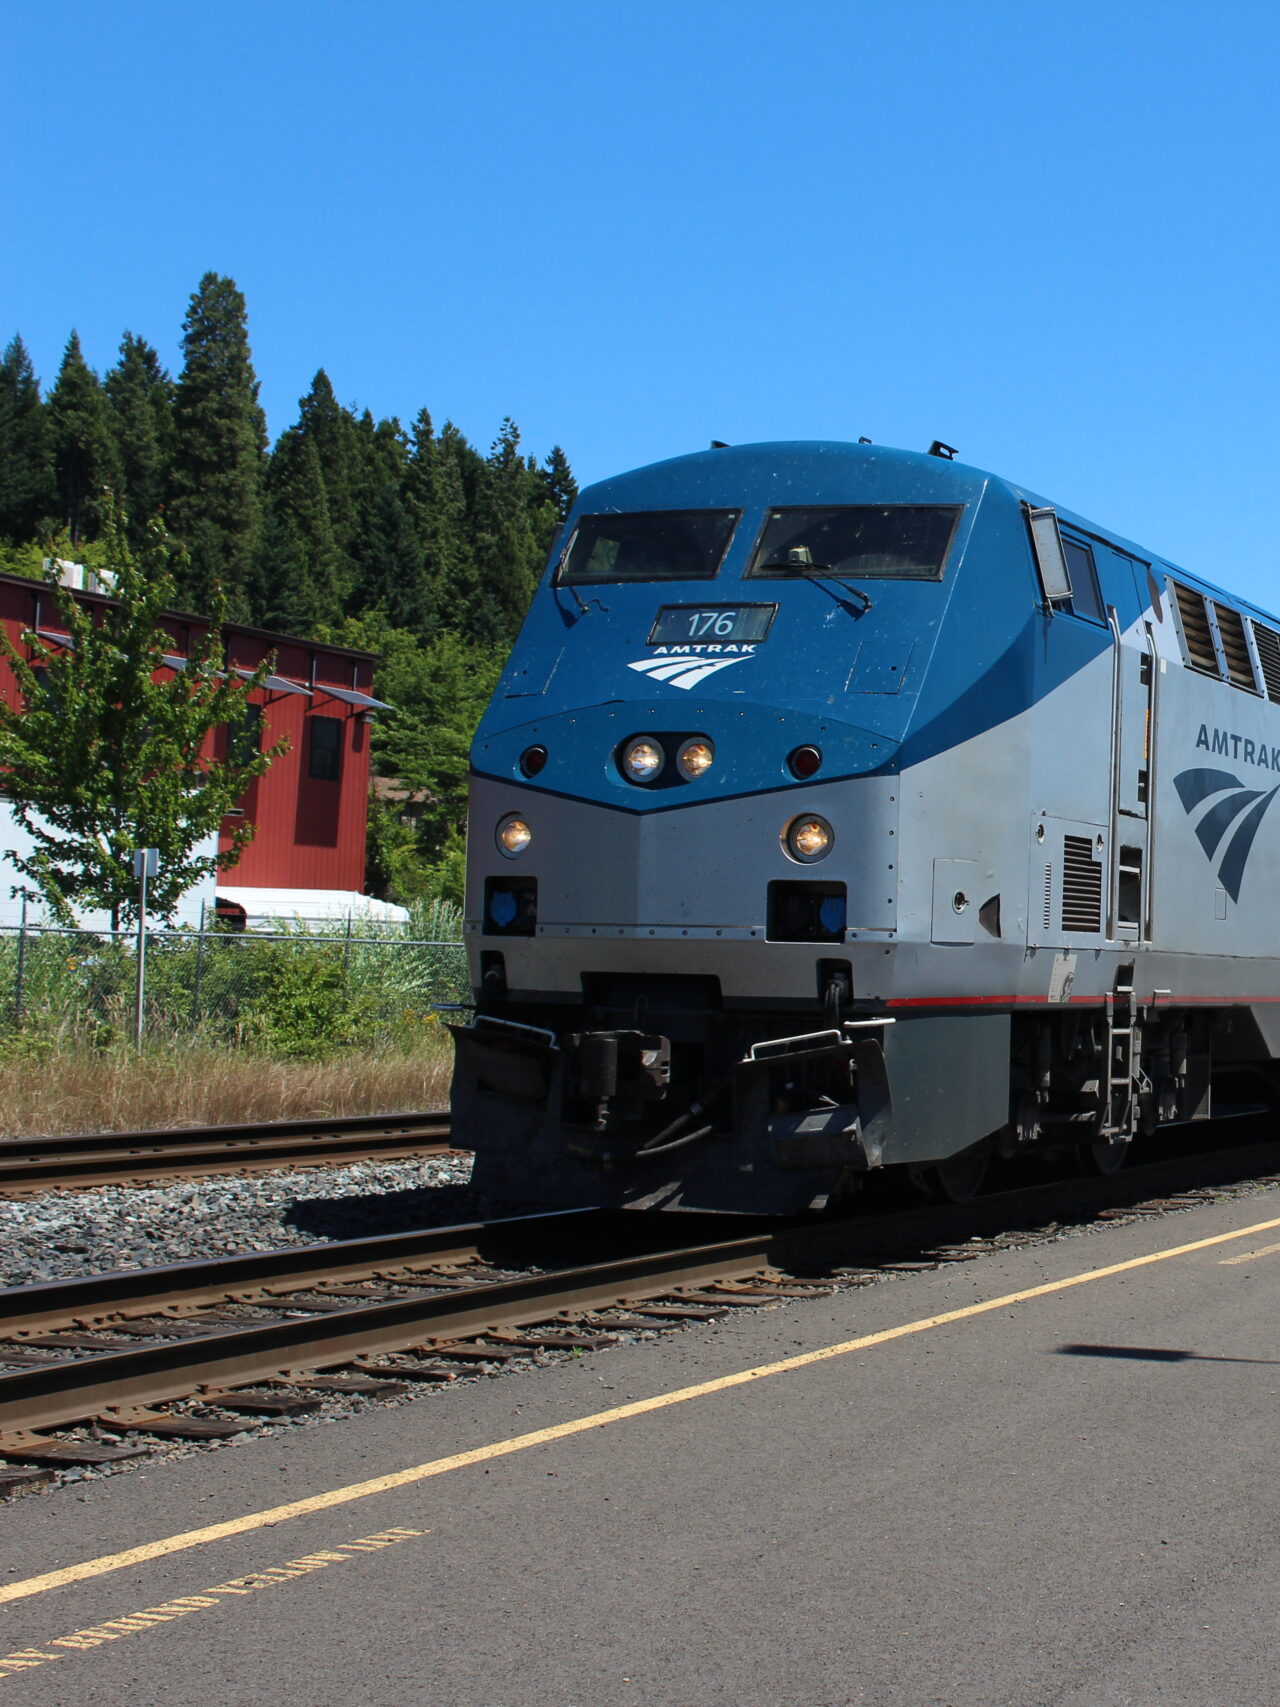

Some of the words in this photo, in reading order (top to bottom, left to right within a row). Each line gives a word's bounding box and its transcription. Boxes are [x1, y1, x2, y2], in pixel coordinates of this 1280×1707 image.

[688, 612, 736, 636] 176
[653, 644, 757, 655] AMTRAK
[45, 1596, 220, 1649] BEHIND
[202, 1550, 353, 1595] YELLOW
[335, 1527, 431, 1551] LINE
